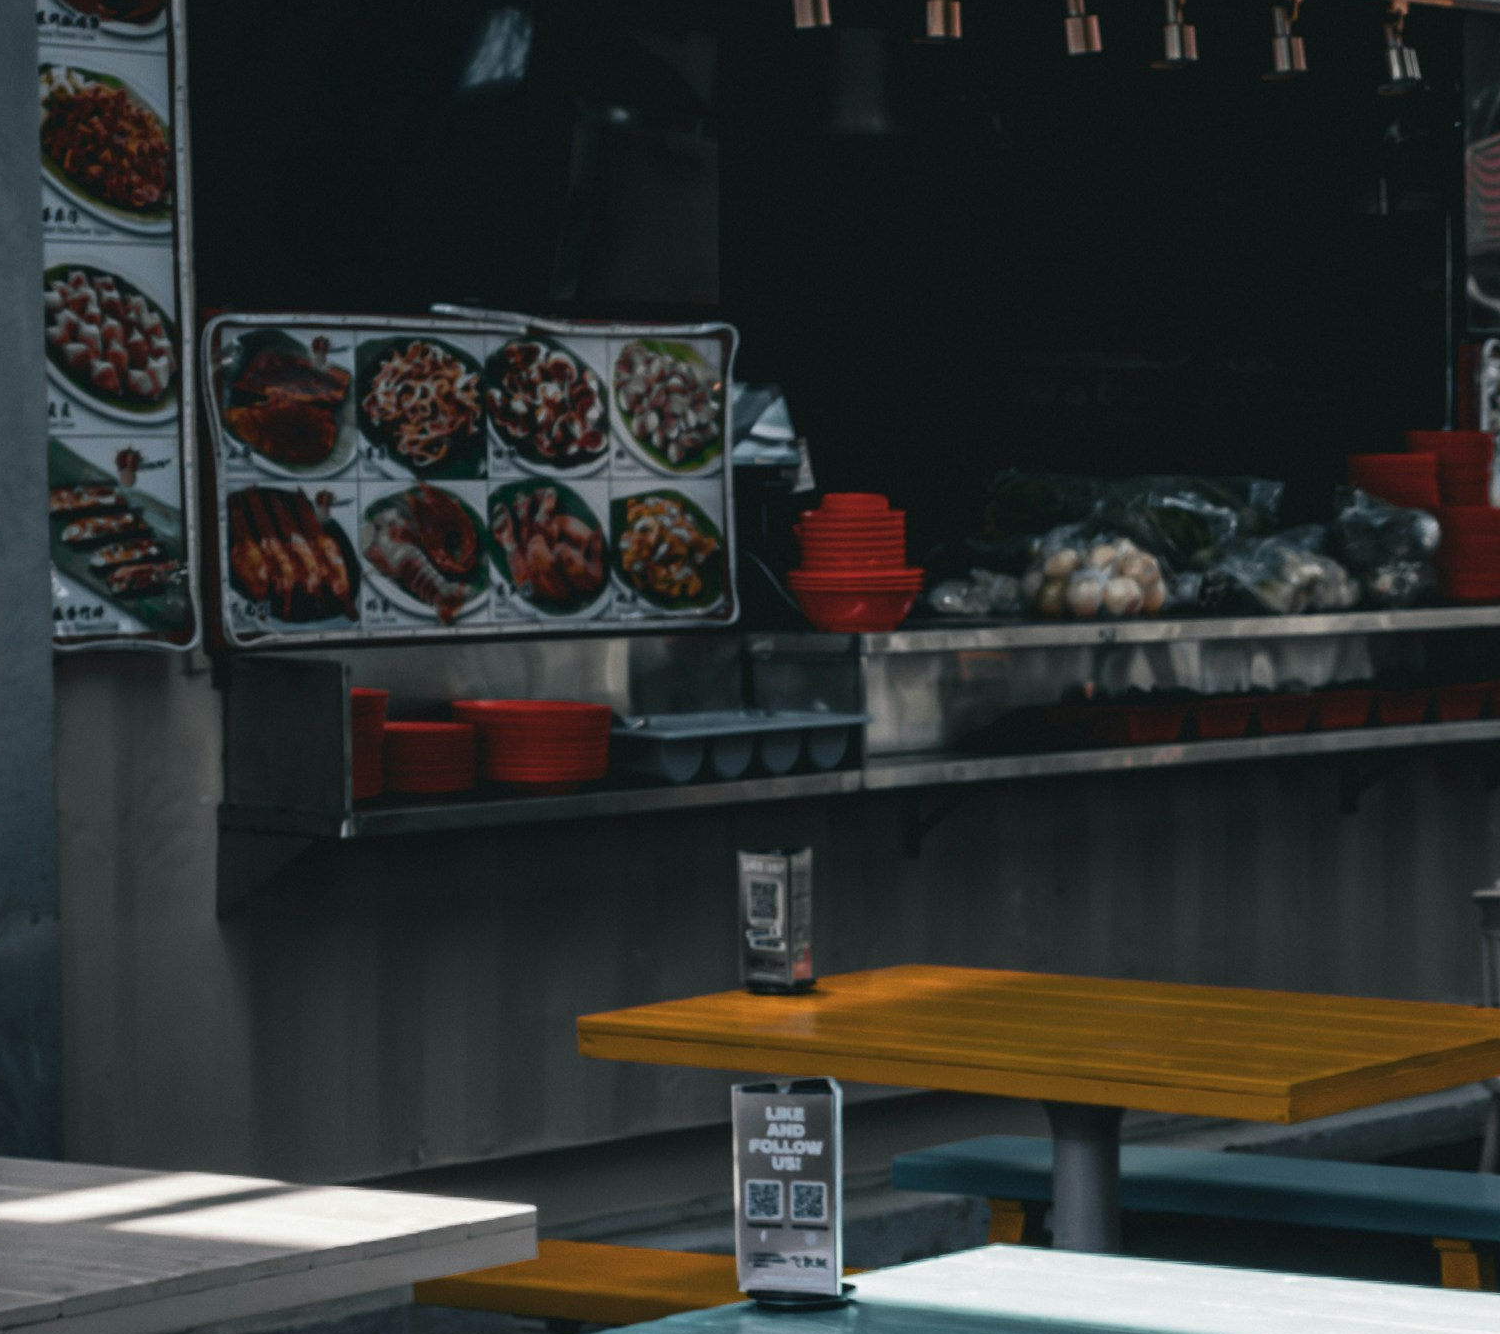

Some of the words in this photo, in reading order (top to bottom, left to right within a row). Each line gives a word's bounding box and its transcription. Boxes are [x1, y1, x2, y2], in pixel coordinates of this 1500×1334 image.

[765, 1106, 805, 1122] LIKE
[767, 1123, 805, 1138] AND
[748, 1138, 823, 1155] FOLLOW
